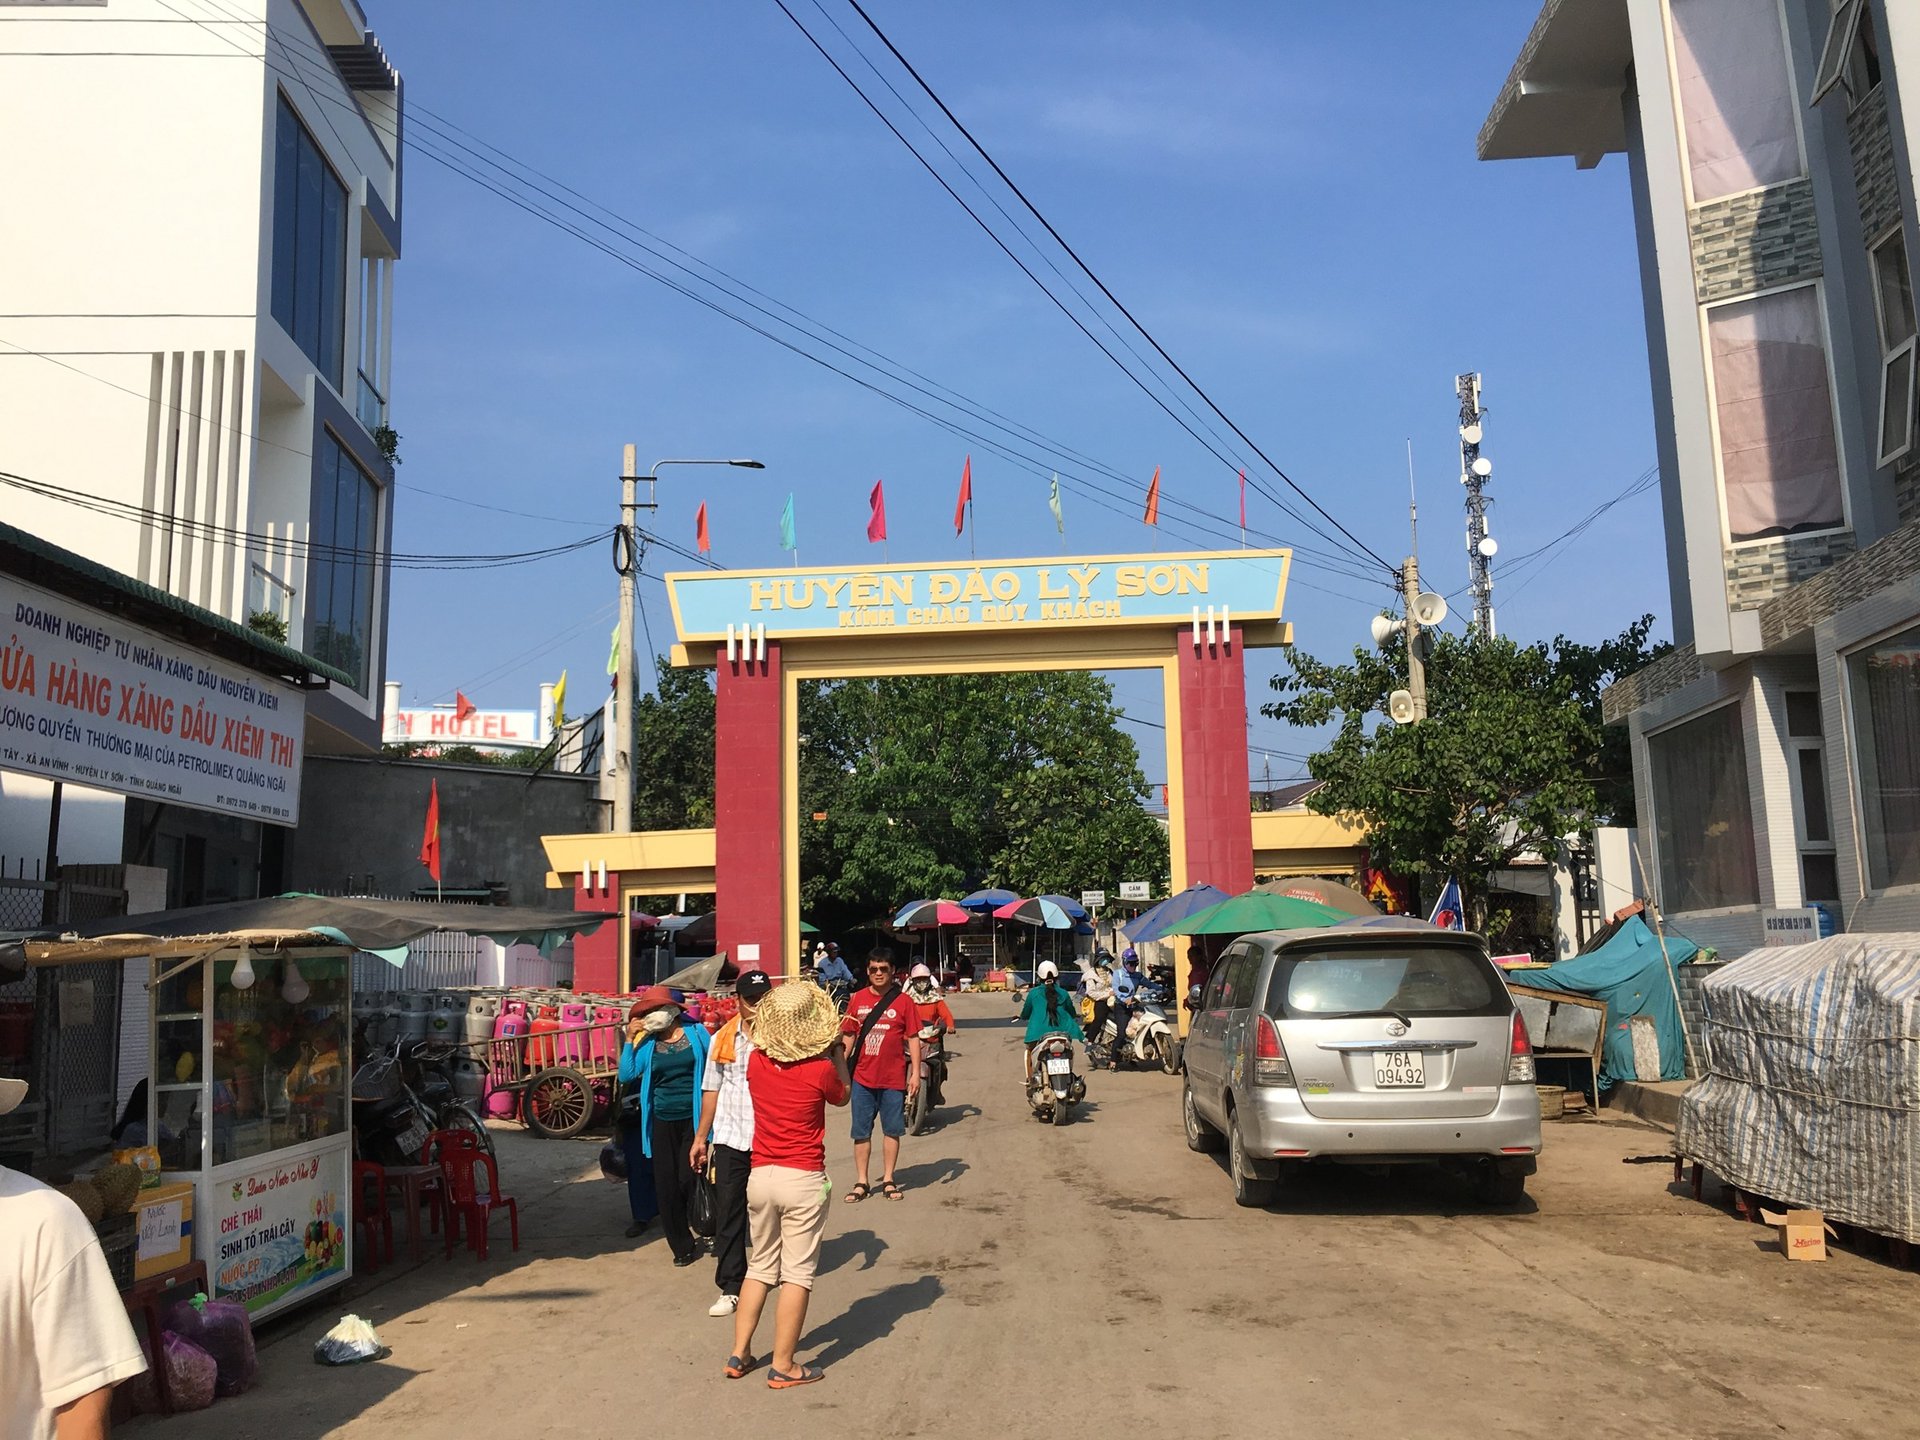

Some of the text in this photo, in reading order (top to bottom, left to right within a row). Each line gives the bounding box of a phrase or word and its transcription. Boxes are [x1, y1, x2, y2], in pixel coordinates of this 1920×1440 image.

[750, 563, 1210, 611] HUYỆN ĐẢO LÝ SƠN
[839, 605, 895, 628] KÍNH
[907, 604, 970, 625] CHÀO
[1041, 597, 1121, 620] KHÁCH
[15, 603, 62, 636] DOANH
[65, 621, 111, 655] NGHIỆP
[115, 639, 131, 660] TƯ
[132, 645, 163, 672] NHÂN
[0, 634, 294, 768] ỬA HÀNG XĂNG DẦU XIÊM THI
[431, 714, 517, 737] HOTEL
[38, 718, 82, 743] QUYỀN
[86, 729, 132, 756] THƯƠNG
[134, 741, 153, 762] MẠI
[155, 745, 176, 767] CỦA
[177, 753, 234, 780] PETROLIMEX
[236, 767, 265, 788] QUẢNG
[266, 776, 286, 793] NGÃI
[39, 757, 50, 767] AN
[111, 771, 124, 783] SƠN
[1385, 1052, 1411, 1068] 76A
[1377, 1068, 1423, 1084] 094.92
[221, 1204, 262, 1234] CHÈ THÁI
[221, 1218, 296, 1260] SINH TỐ TRÁI CÂY
[221, 1256, 260, 1286] NƯỚC ÉP
